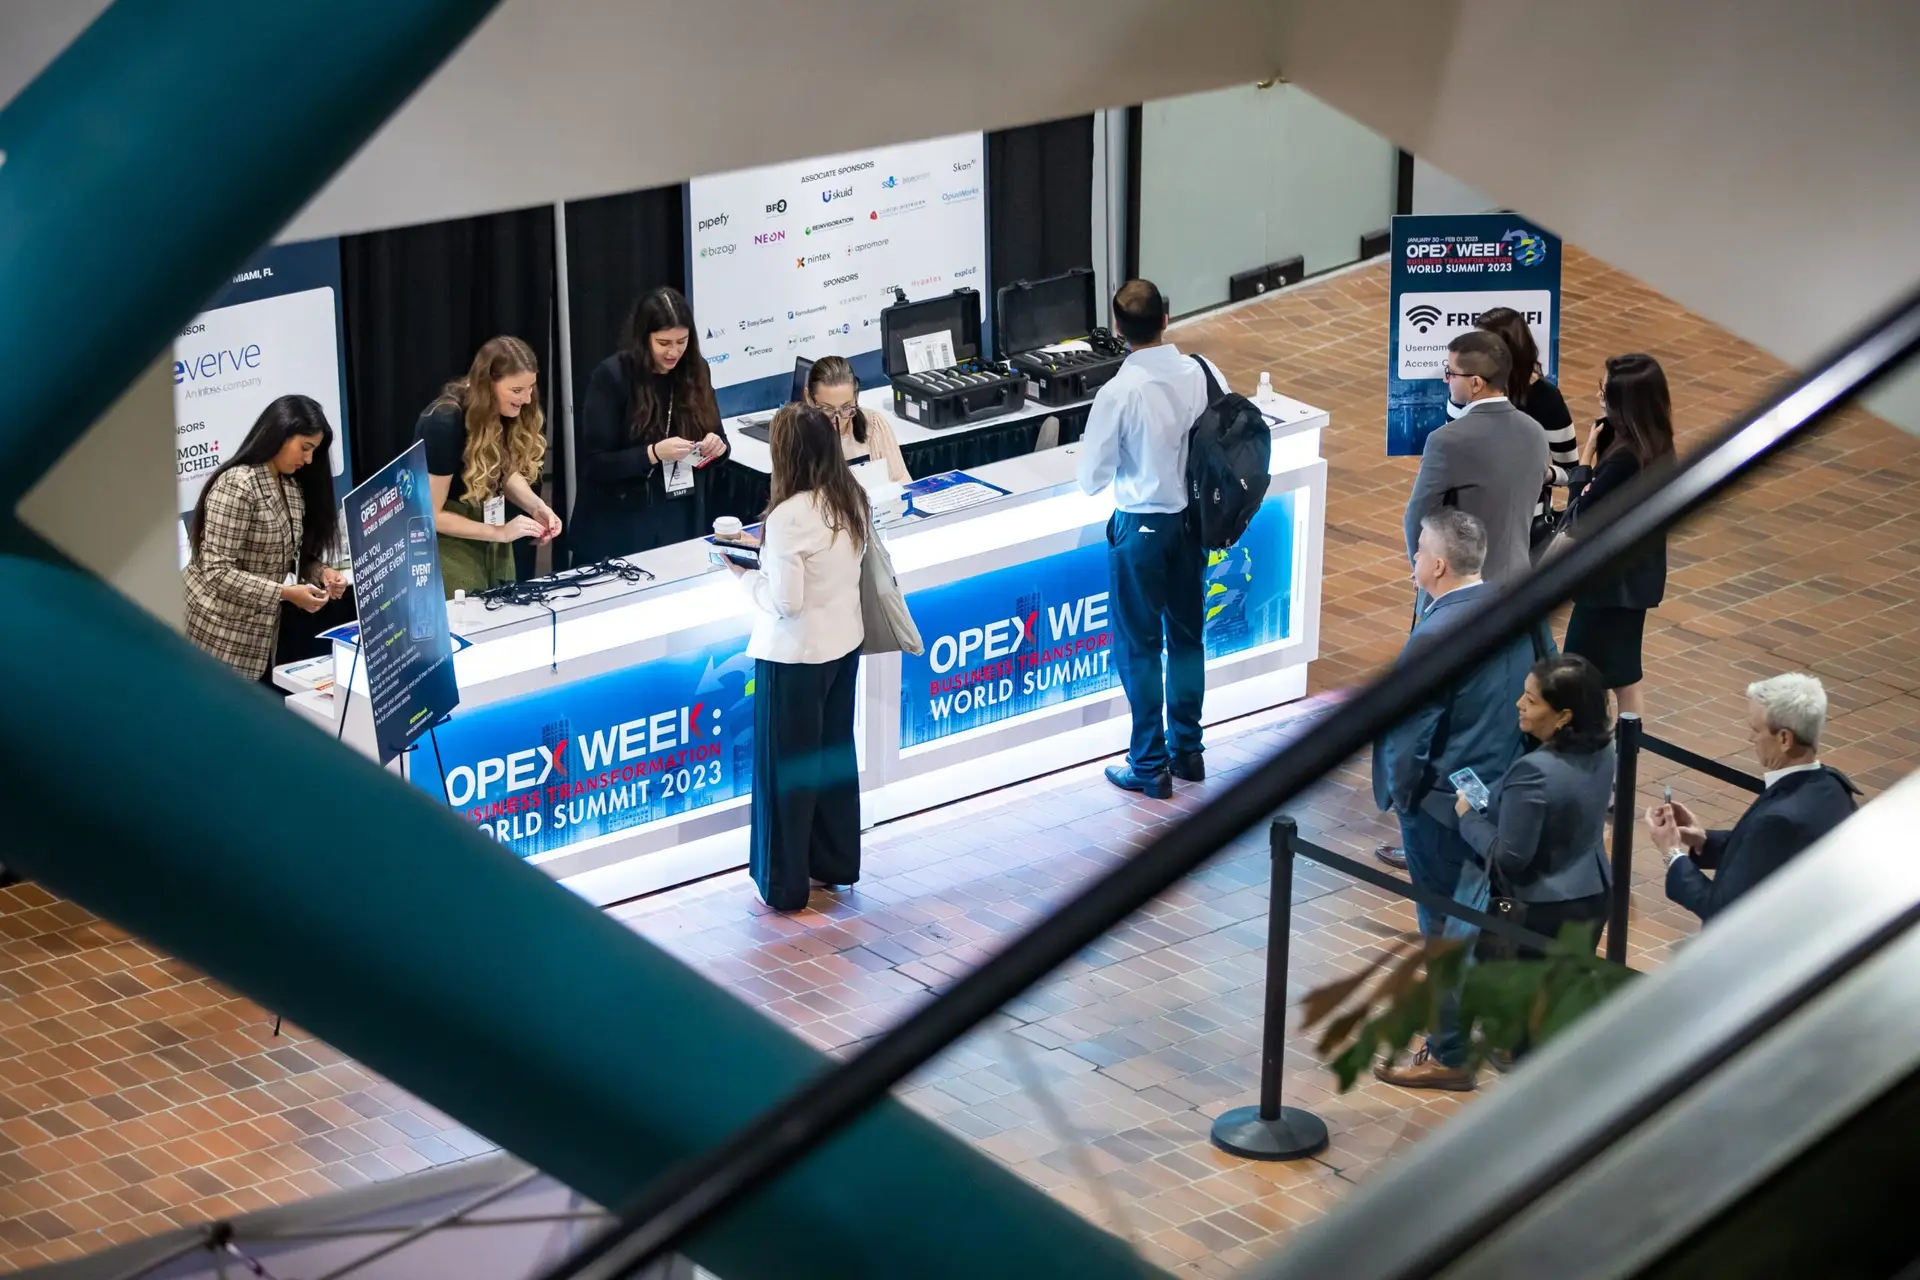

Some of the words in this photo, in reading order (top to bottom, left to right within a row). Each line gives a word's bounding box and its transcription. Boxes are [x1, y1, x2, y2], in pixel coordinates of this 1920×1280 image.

[801, 169, 837, 184] ASSOCIATE
[838, 160, 874, 177] SPONSORS
[832, 187, 853, 200] skuid
[698, 213, 729, 232] pipefy
[812, 216, 854, 231] REINVIGORATION
[754, 230, 786, 245] NEON
[855, 238, 889, 253] apromore
[807, 252, 831, 264] nintex
[1406, 244, 1452, 258] OPEX
[233, 270, 262, 284] MIAMI,
[263, 267, 274, 277] FL
[1407, 265, 1442, 274] WORLD
[1446, 264, 1484, 273] SUMMIT
[1488, 263, 1512, 272] 2023
[824, 272, 859, 288] SPONSORS
[1405, 359, 1438, 368] Access
[222, 375, 262, 392] company
[354, 552, 368, 569] HAVE
[369, 542, 380, 557] YOU
[356, 547, 394, 583] DOWNLOADED
[394, 538, 405, 552] THE
[358, 578, 373, 596] OPEX
[373, 568, 388, 583] WEEK
[390, 552, 406, 571] EVENT
[412, 563, 431, 576] EVENT
[416, 576, 428, 587] APP
[360, 595, 370, 609] APP
[371, 583, 384, 600] YET?
[929, 611, 1038, 674] OPEX
[1048, 592, 1110, 642] WE
[929, 658, 1013, 695] BUSINESS
[929, 682, 1013, 721] WORLD
[1023, 650, 1110, 695] SUMMIT
[445, 739, 568, 807] OPEX
[547, 742, 722, 803] TRANSFORMATION
[553, 778, 651, 829] SUMMIT
[660, 760, 722, 799] 2023
